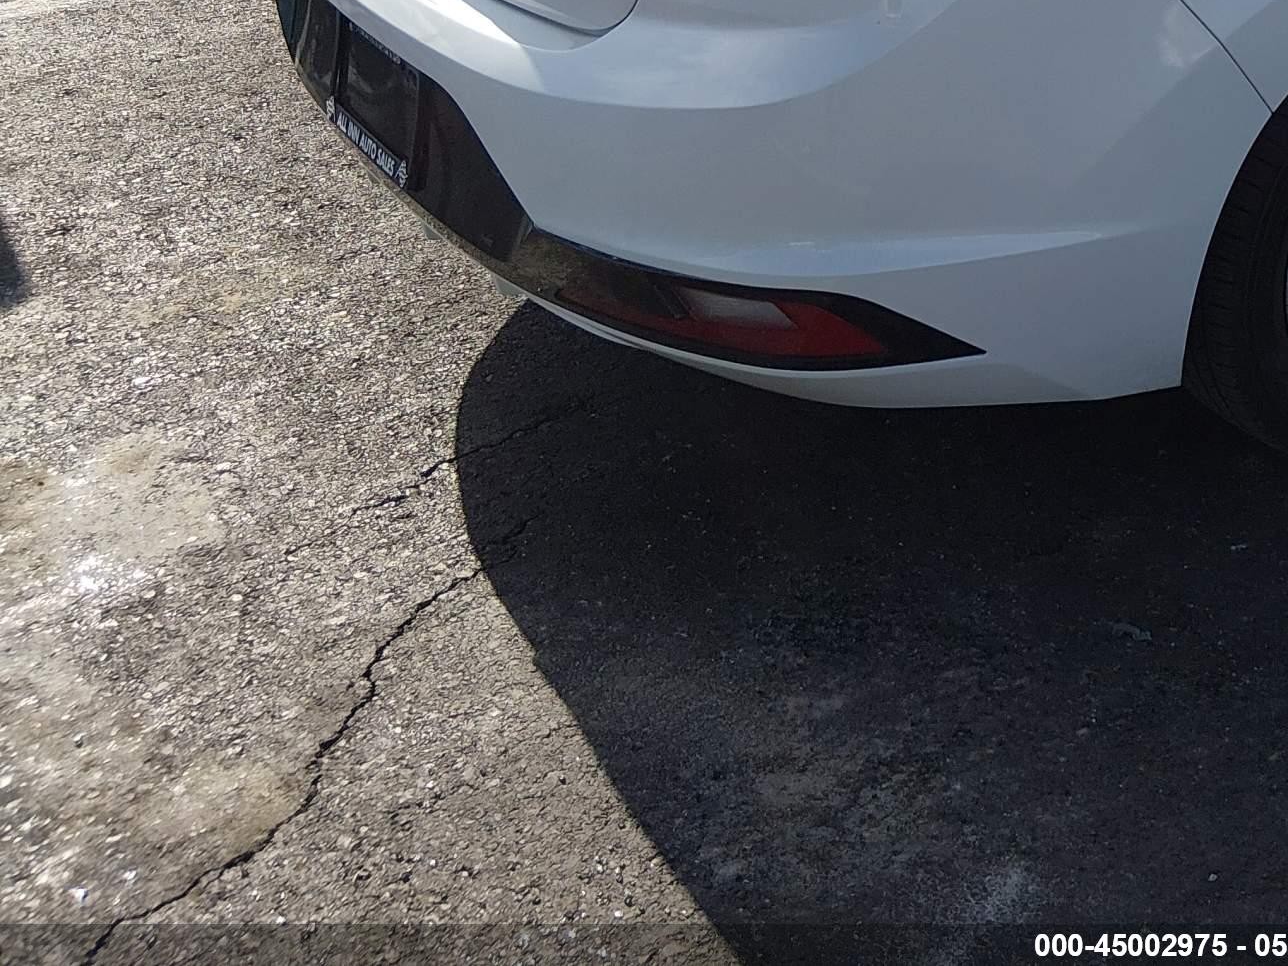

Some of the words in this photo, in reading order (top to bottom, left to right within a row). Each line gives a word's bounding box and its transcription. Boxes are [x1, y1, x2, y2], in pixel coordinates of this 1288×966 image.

[336, 112, 348, 134] ALL
[359, 133, 377, 160] AUTO
[376, 148, 395, 177] SALES
